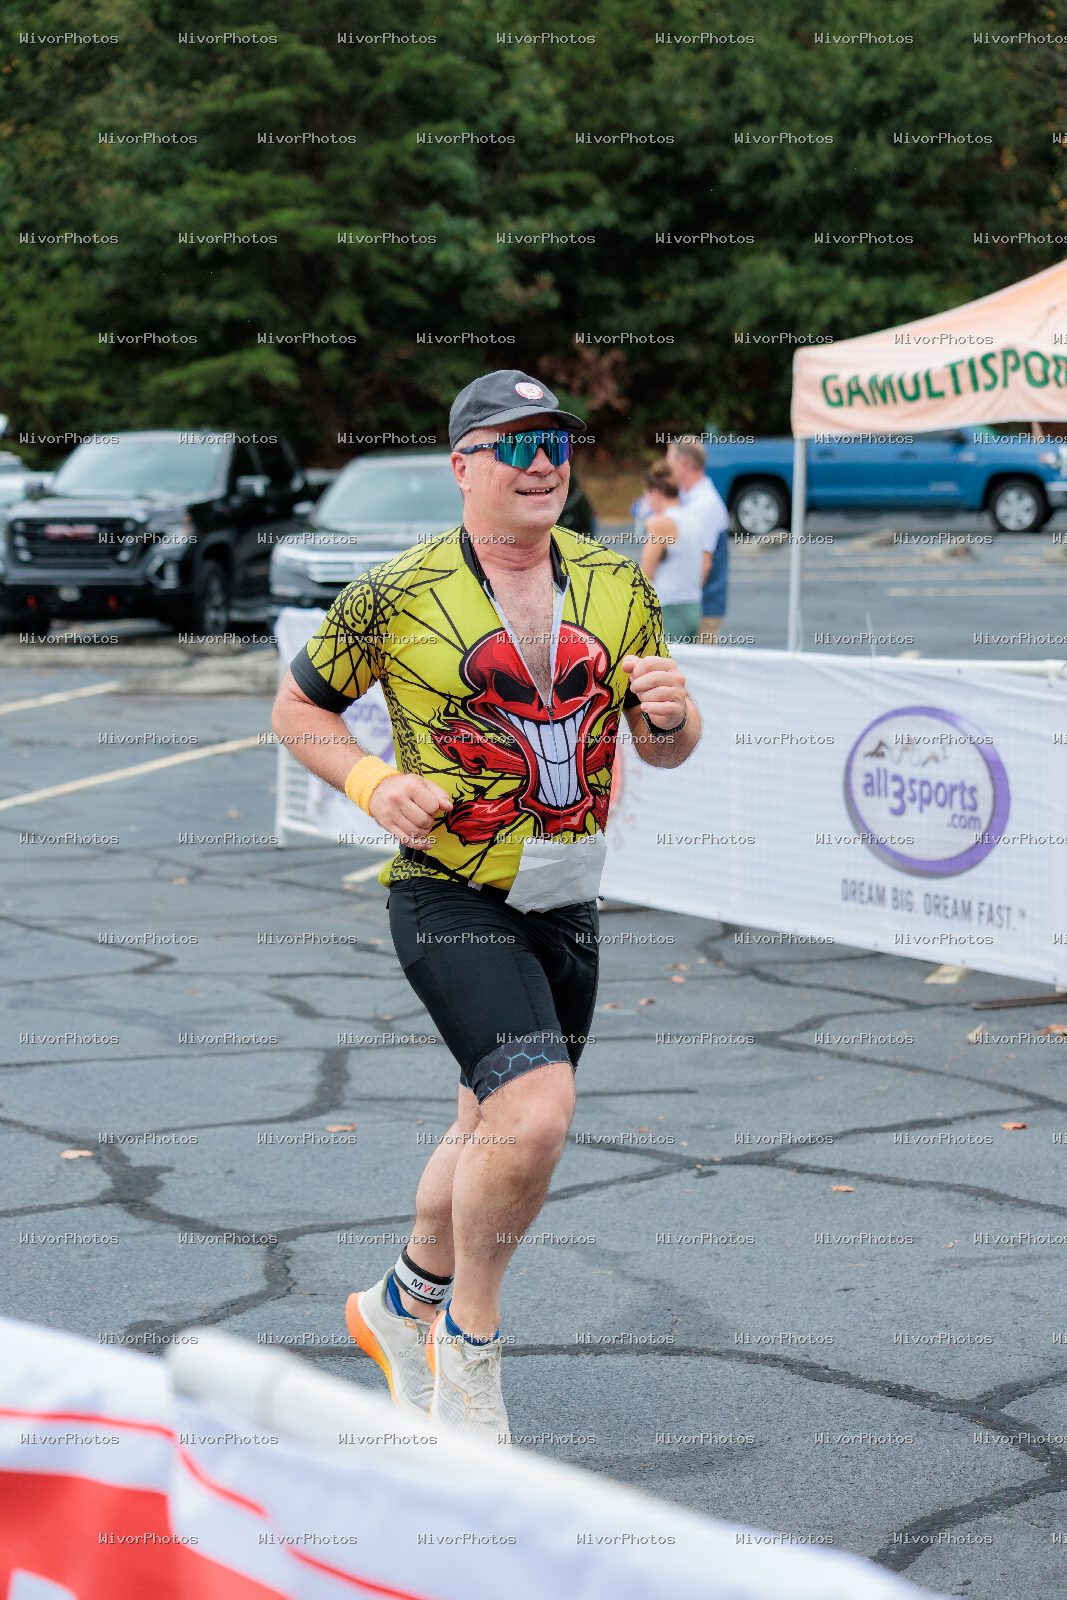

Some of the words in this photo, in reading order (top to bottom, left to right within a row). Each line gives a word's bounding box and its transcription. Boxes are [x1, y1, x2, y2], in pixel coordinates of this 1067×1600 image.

[864, 768, 978, 816] all3sports
[841, 878, 885, 908] DREAM
[923, 892, 972, 924] DREAM
